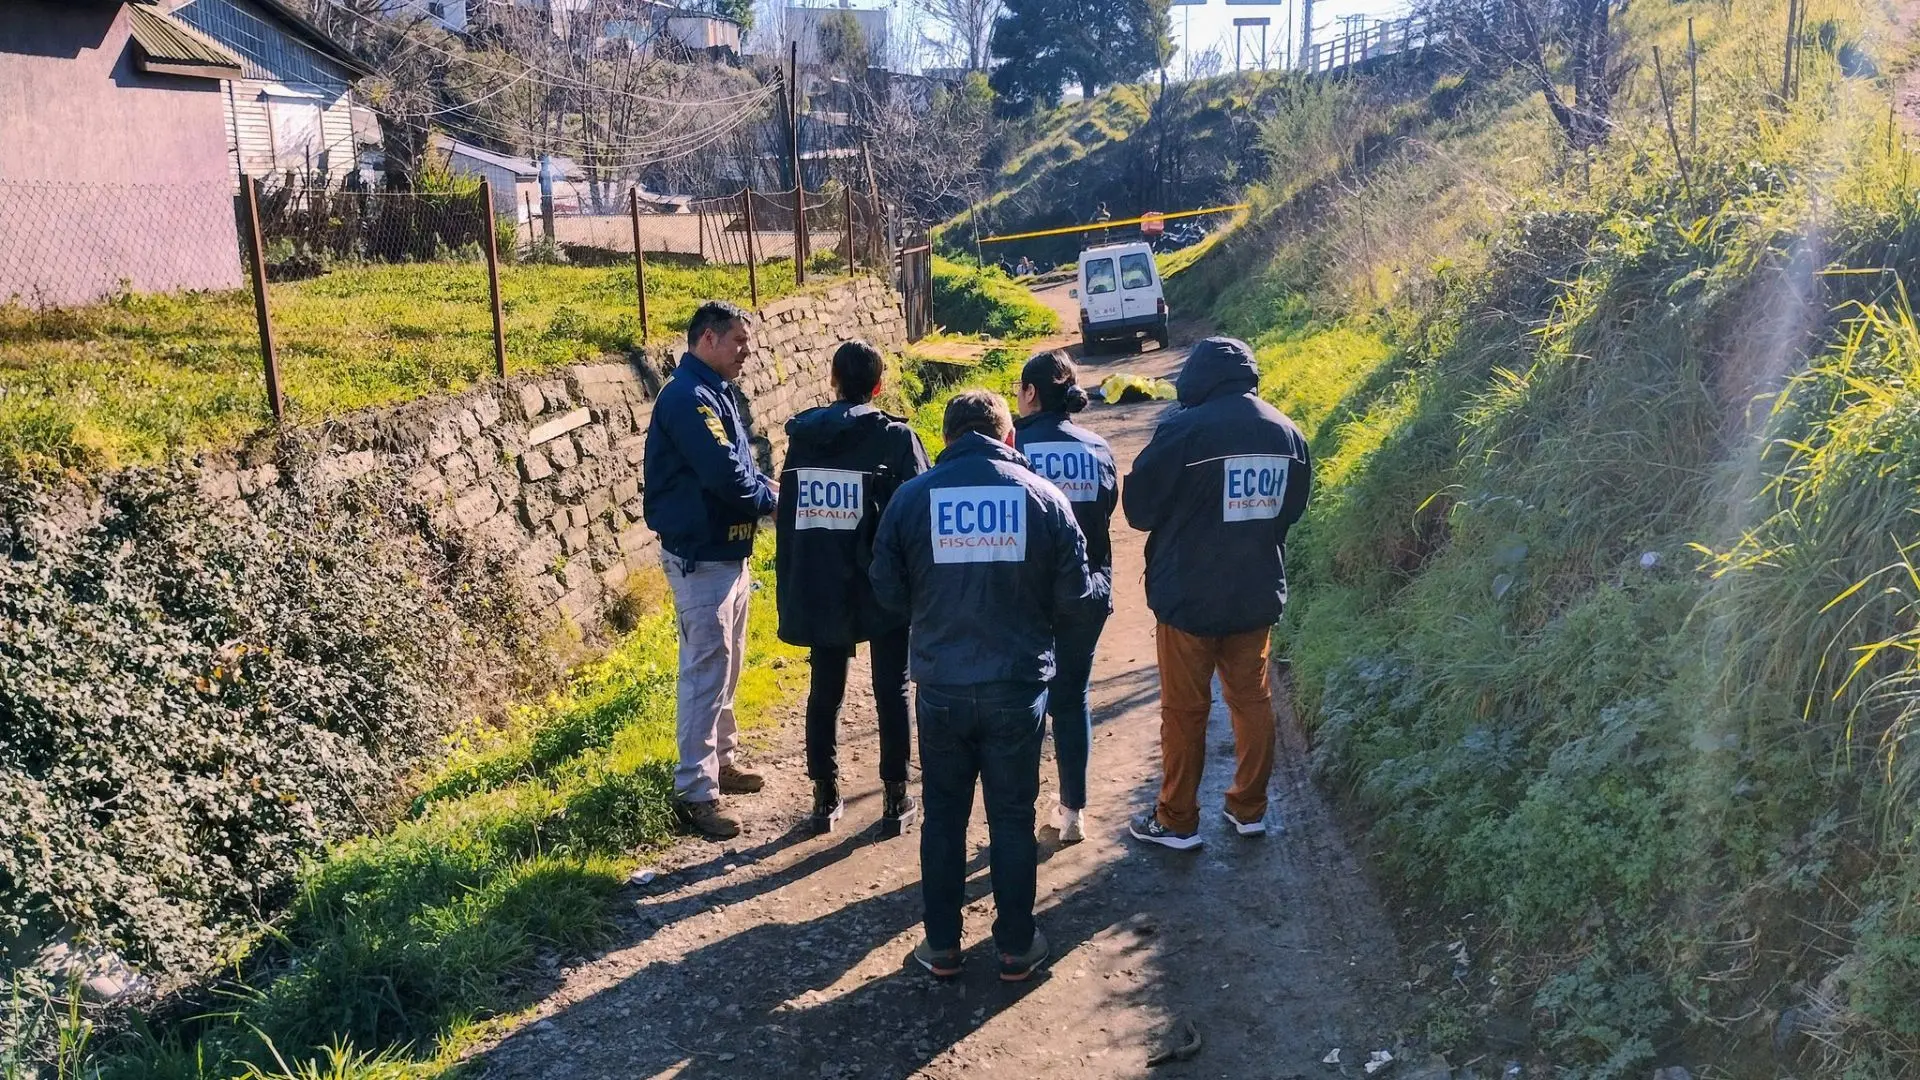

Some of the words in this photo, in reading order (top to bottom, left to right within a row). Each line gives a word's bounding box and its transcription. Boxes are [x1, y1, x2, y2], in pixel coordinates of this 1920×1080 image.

[1030, 452, 1095, 480] ECOH
[798, 480, 859, 509] ECOH
[1054, 481, 1094, 490] ALIA
[1228, 467, 1285, 499] ECOH
[798, 508, 858, 519] FISCALIA
[938, 499, 1019, 535] ECOH
[939, 536, 1018, 548] FISCALIA
